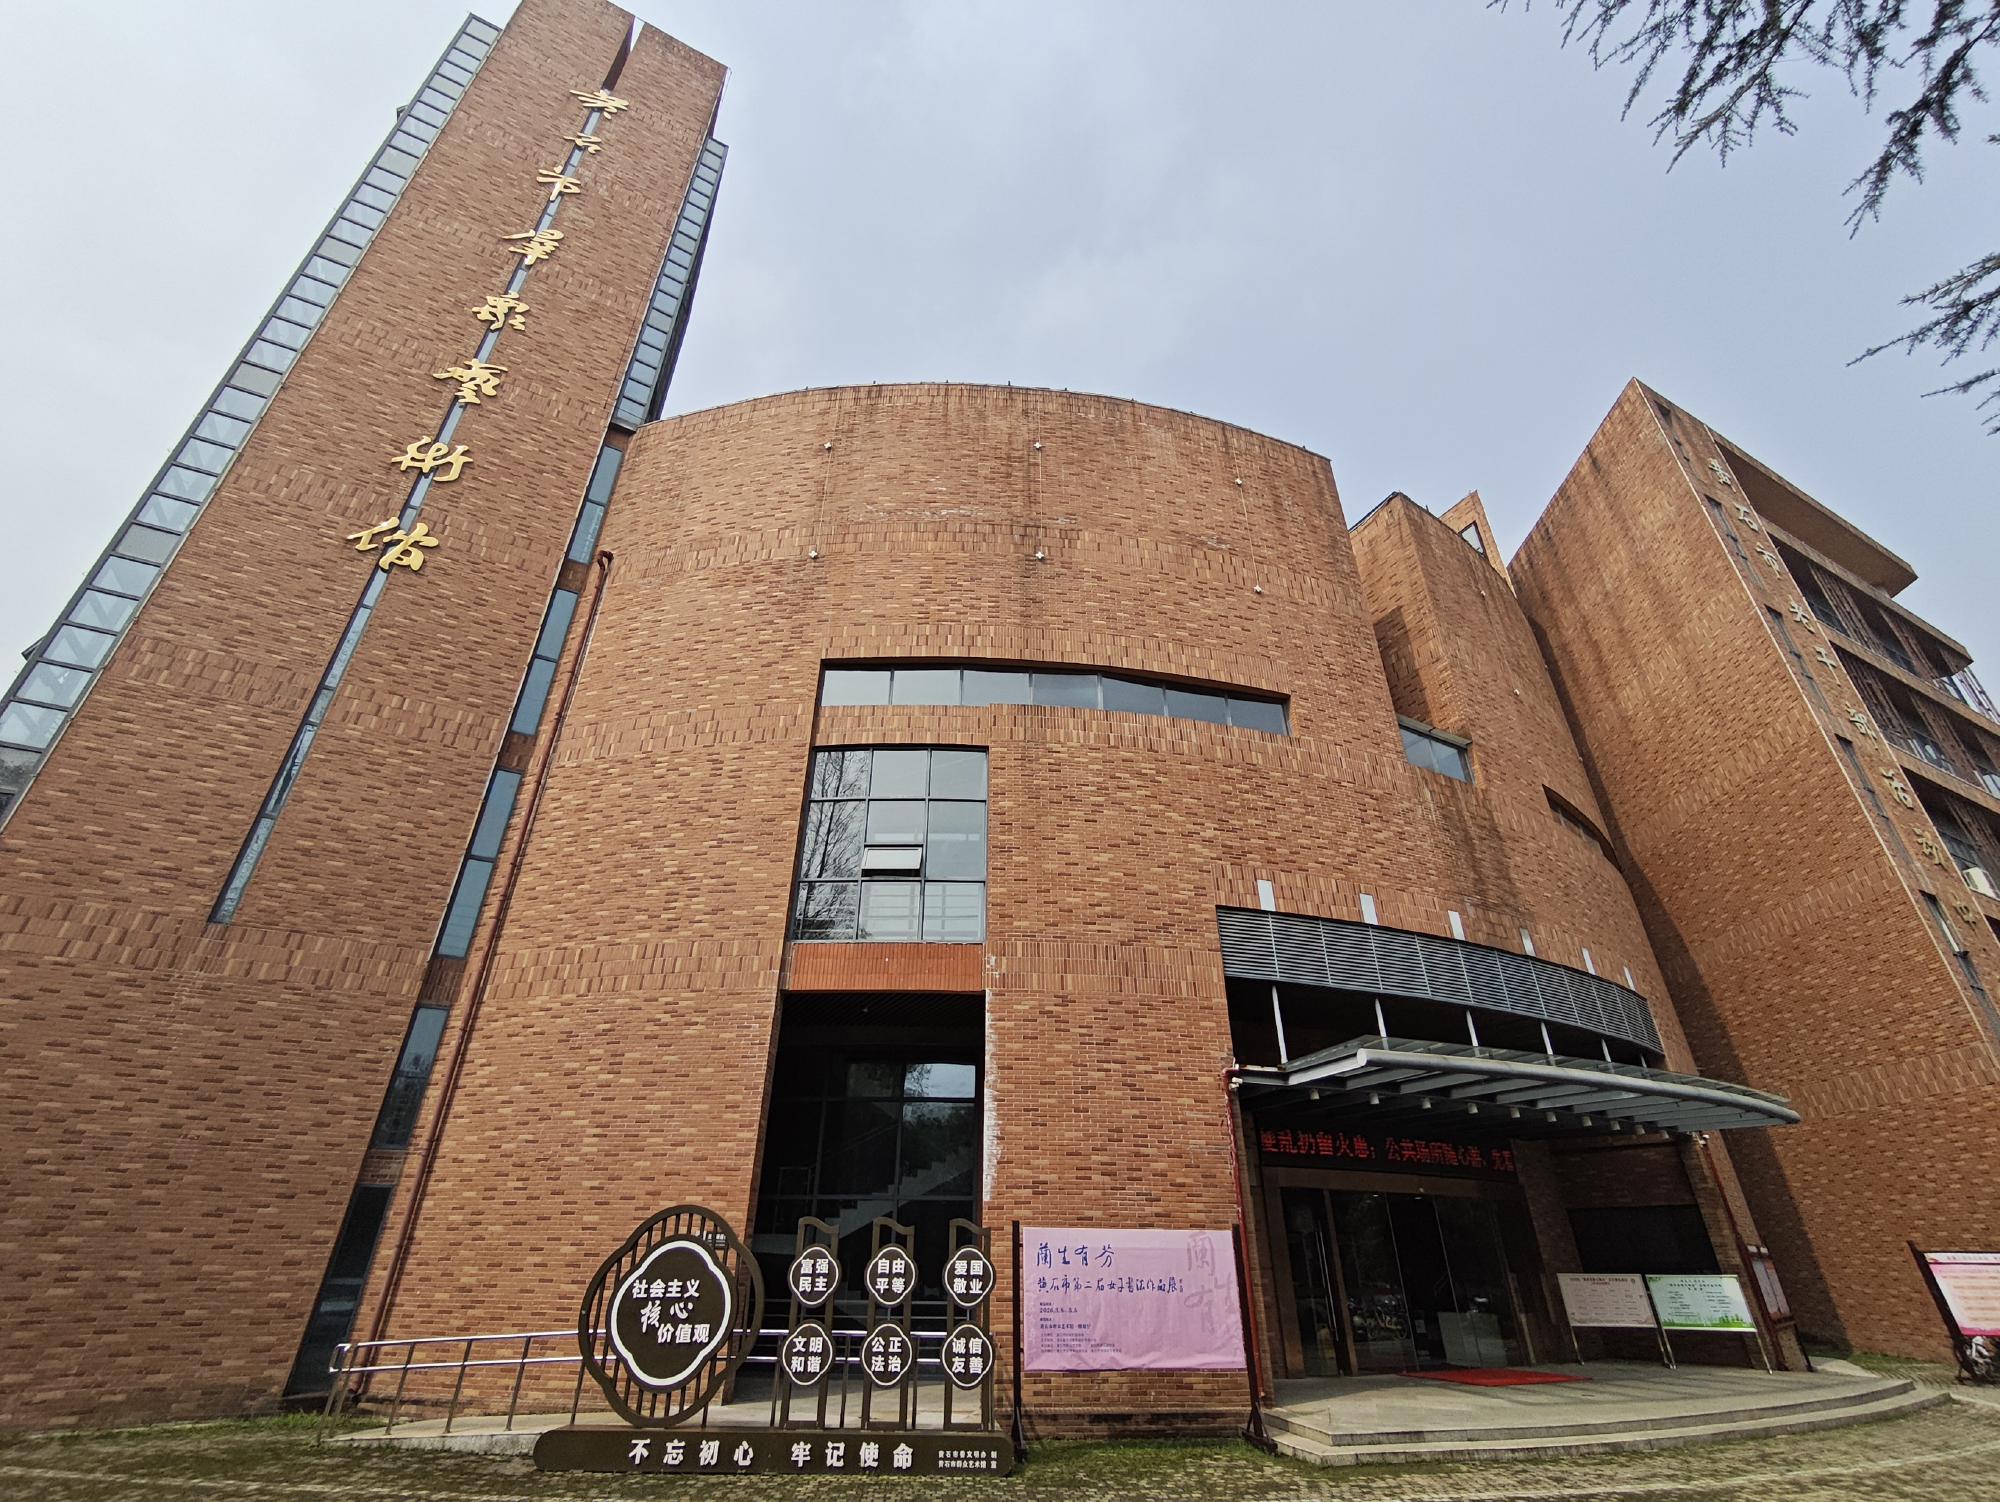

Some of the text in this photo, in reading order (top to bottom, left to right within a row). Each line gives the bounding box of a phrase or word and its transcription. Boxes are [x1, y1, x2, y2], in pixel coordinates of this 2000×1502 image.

[800, 1258, 830, 1275] 富强
[877, 1258, 906, 1275] 自由
[954, 1259, 984, 1276] 爱国
[631, 1278, 701, 1299] 社会主义
[798, 1276, 828, 1293] 民主
[874, 1277, 906, 1294] 平等
[953, 1278, 984, 1295] 敬业
[639, 1299, 694, 1334] 核心
[656, 1323, 712, 1344] 价值观
[792, 1336, 824, 1353] 文明
[871, 1336, 903, 1353] 公正
[951, 1337, 983, 1355] 诚信
[790, 1356, 823, 1373] 和谐
[870, 1355, 902, 1373] 法治
[951, 1357, 984, 1374] 友善
[627, 1438, 916, 1470] 不忘初心 牢记使命
[937, 1450, 987, 1459] 黄石市委文明办
[937, 1460, 987, 1469] 黄石市群众艺术馆
